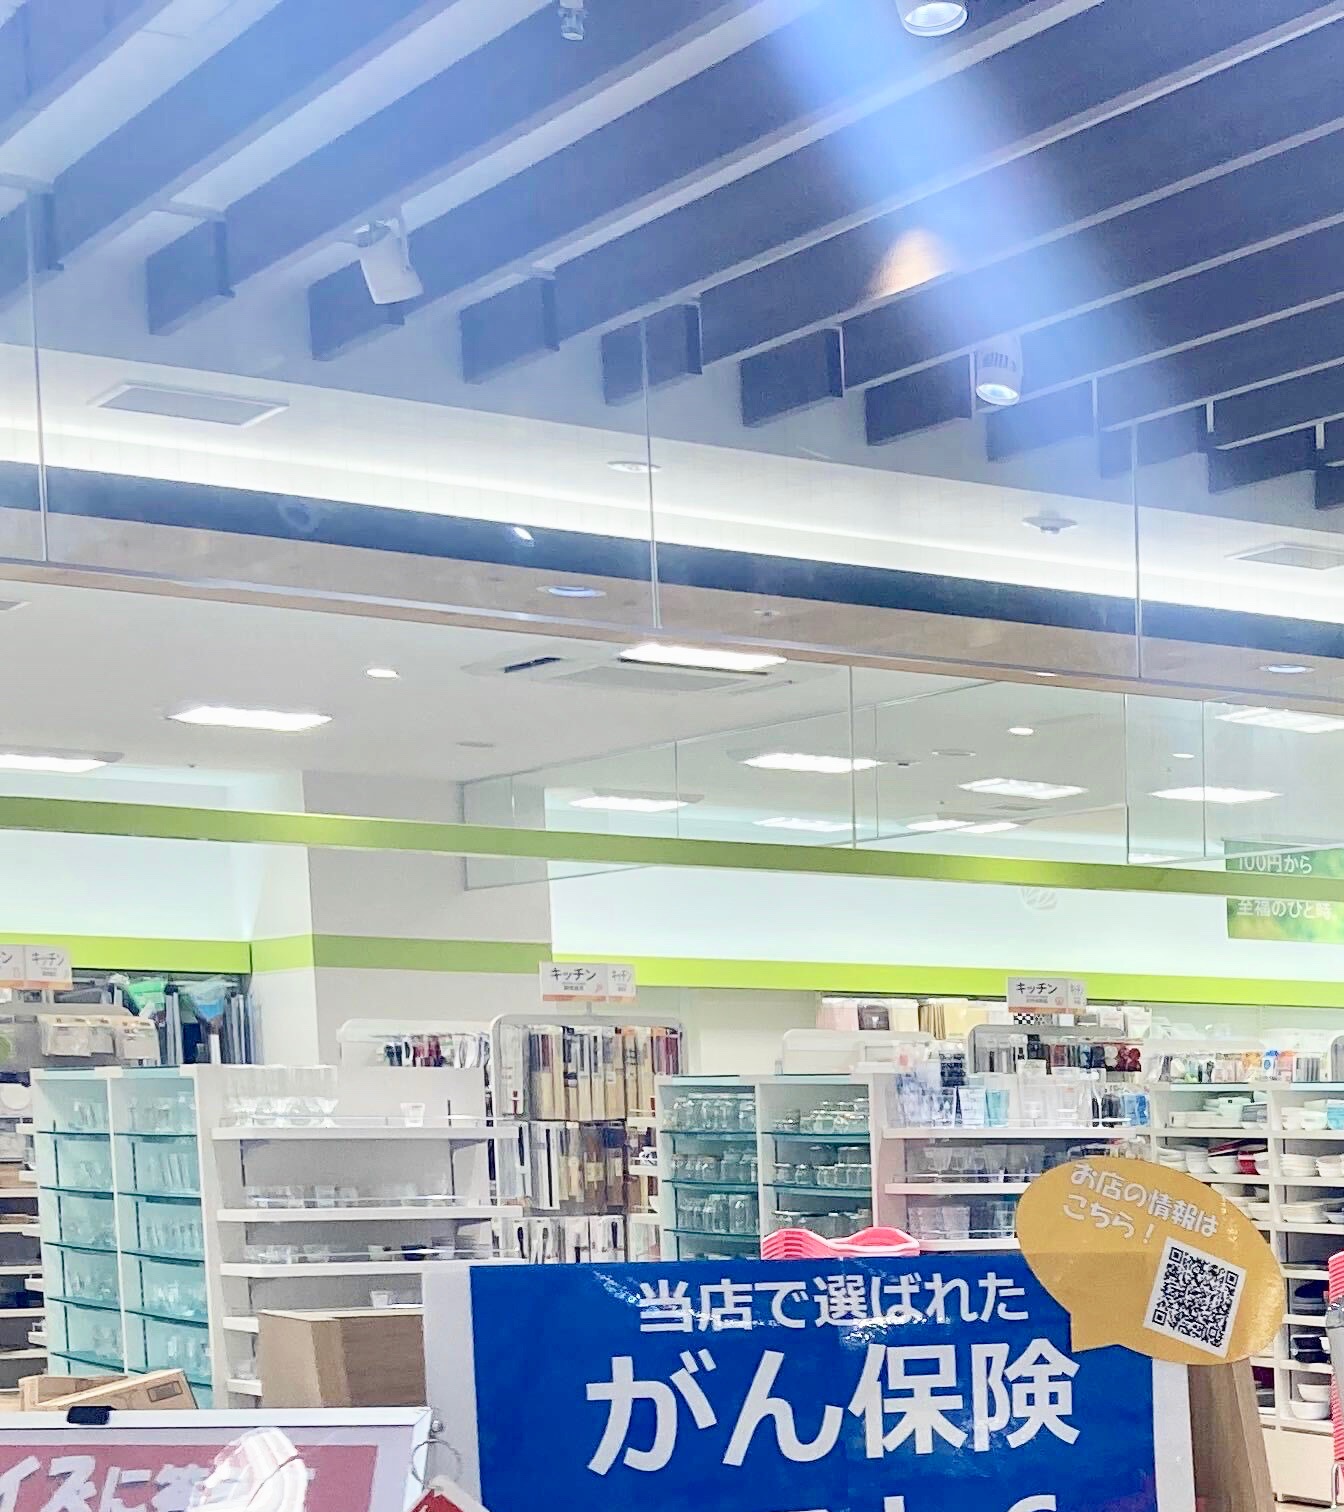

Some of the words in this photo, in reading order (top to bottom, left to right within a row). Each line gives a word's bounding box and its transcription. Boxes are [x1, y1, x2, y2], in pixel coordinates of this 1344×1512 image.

[552, 967, 597, 981] キッチン
[1016, 982, 1058, 995] キッチン
[1062, 1195, 1153, 1244] こちら！
[1071, 1161, 1219, 1238] お店の情報は
[639, 1271, 1029, 1333] 当店で選ばれた
[585, 1336, 1081, 1479] がん保険
